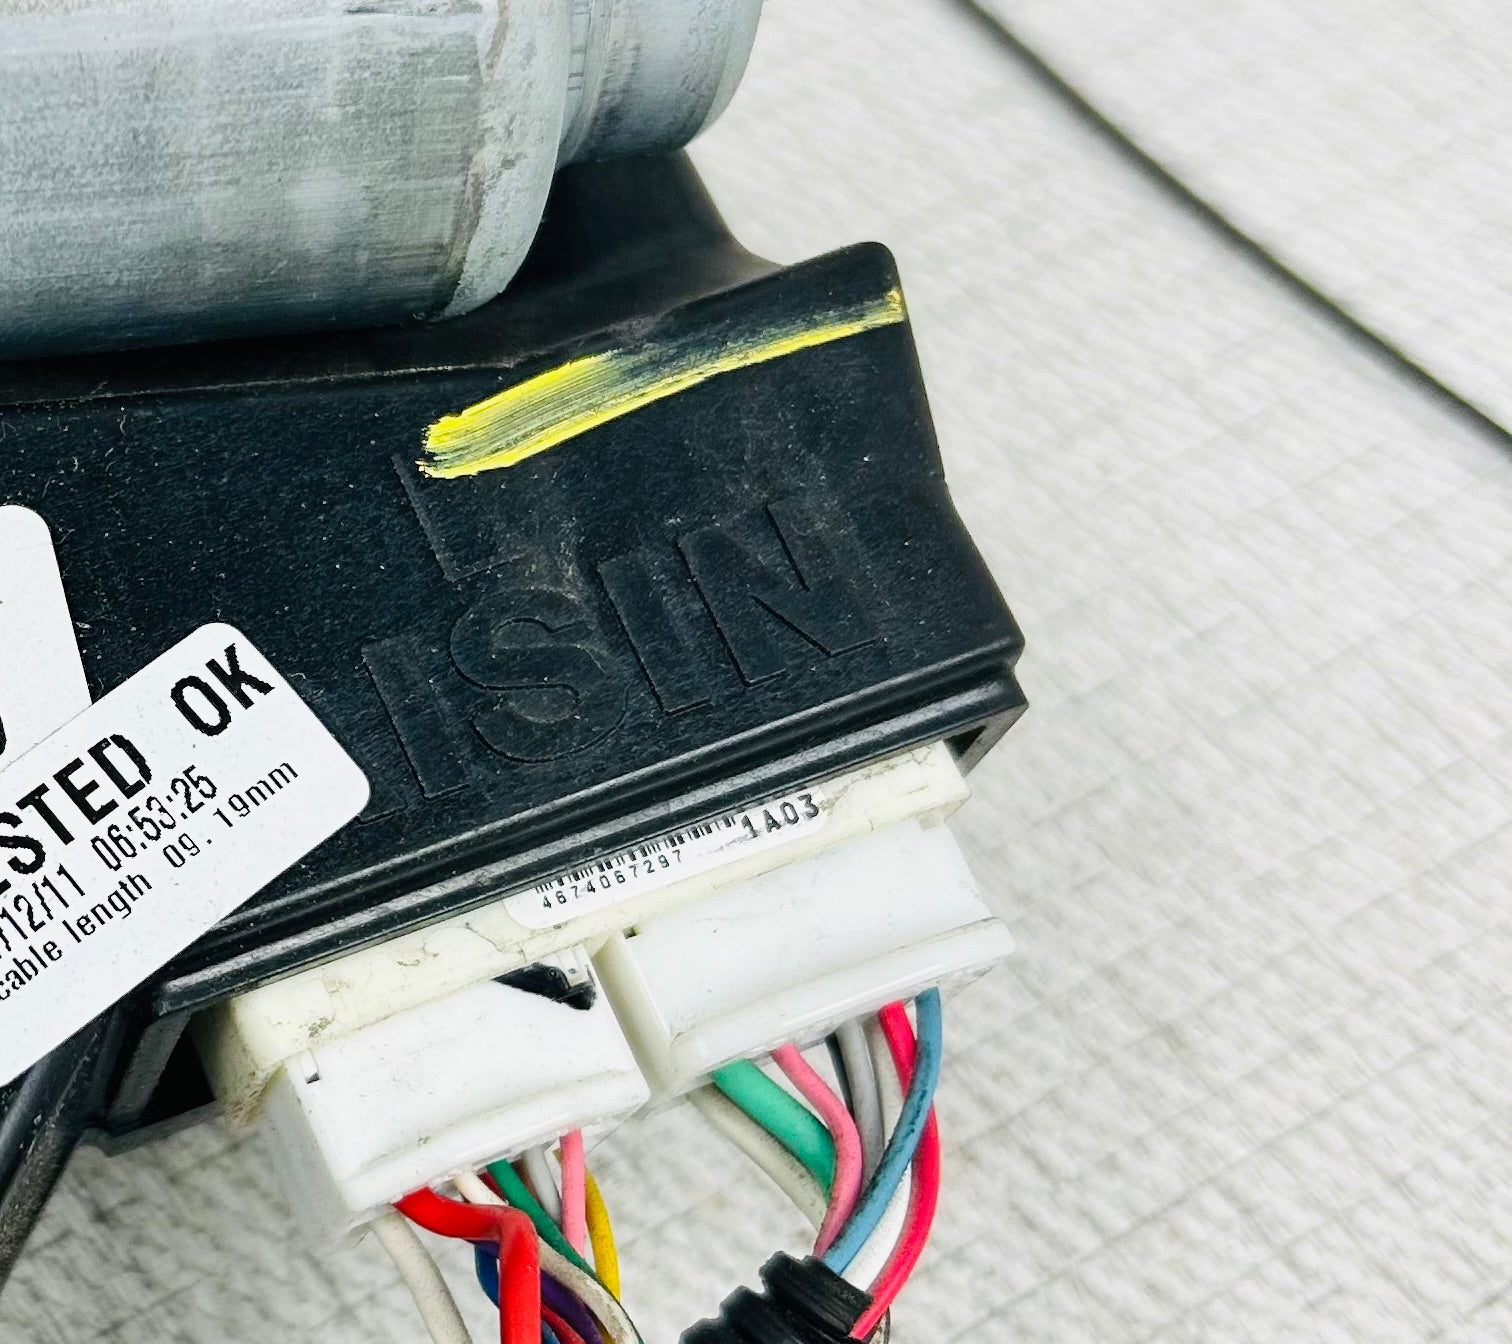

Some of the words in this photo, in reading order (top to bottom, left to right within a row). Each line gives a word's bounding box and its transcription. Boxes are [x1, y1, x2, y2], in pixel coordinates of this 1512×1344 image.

[169, 642, 276, 737] OK
[356, 496, 888, 824] ISIN
[90, 764, 218, 872] 06:53:25
[740, 792, 820, 840] 1A03
[62, 873, 153, 944] length
